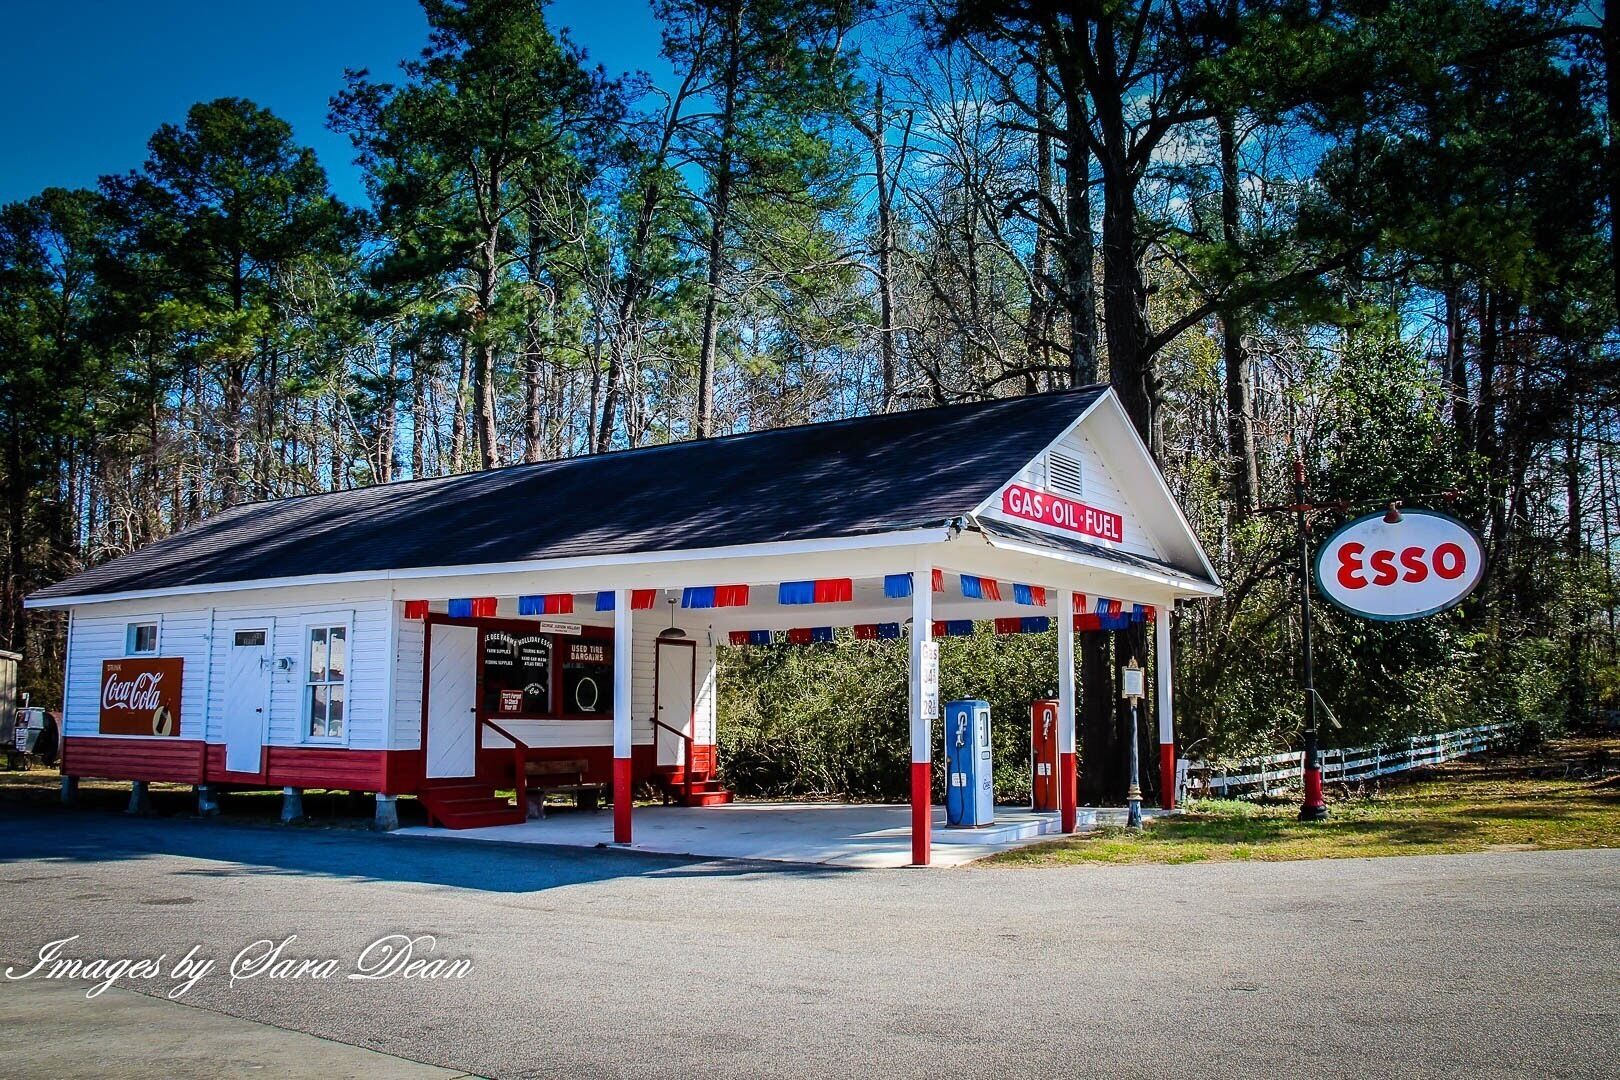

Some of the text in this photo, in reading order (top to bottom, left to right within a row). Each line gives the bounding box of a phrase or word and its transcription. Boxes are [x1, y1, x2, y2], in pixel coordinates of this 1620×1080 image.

[1008, 488, 1119, 539] GAS OIL FUEL
[1337, 542, 1466, 590] ESSO
[490, 633, 500, 641] DEE
[518, 636, 553, 650] HOLLIDAY ESSO
[571, 644, 603, 654] USED TIRE
[570, 652, 604, 662] BARGAINS
